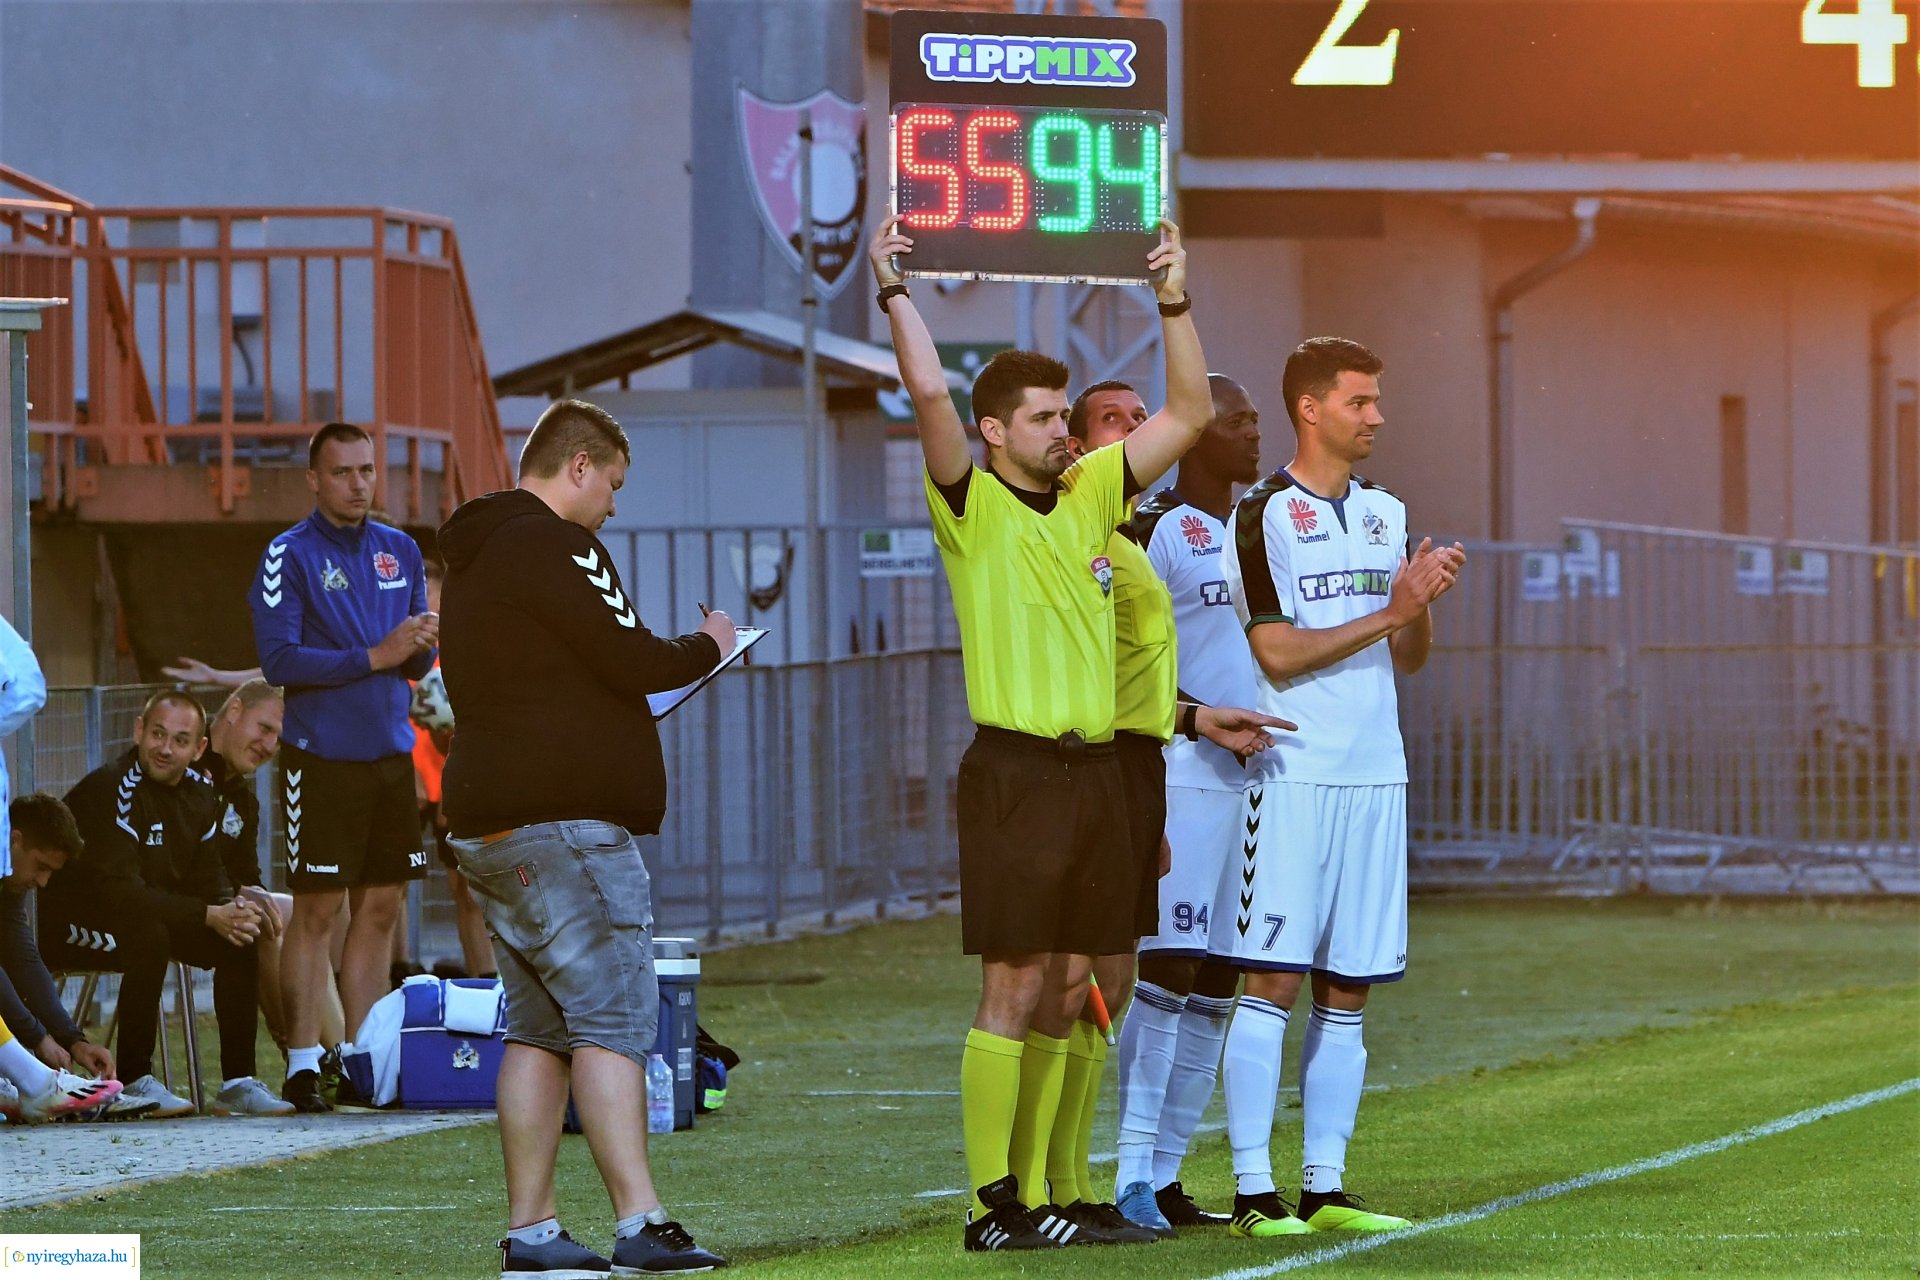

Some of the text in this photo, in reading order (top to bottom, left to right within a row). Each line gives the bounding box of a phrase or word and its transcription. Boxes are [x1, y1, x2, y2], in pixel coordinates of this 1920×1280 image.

[901, 112, 1025, 229] 55
[1032, 116, 1157, 231] 94
[1297, 531, 1331, 544] hummel
[1172, 902, 1208, 935] 94
[1262, 914, 1286, 950] 7
